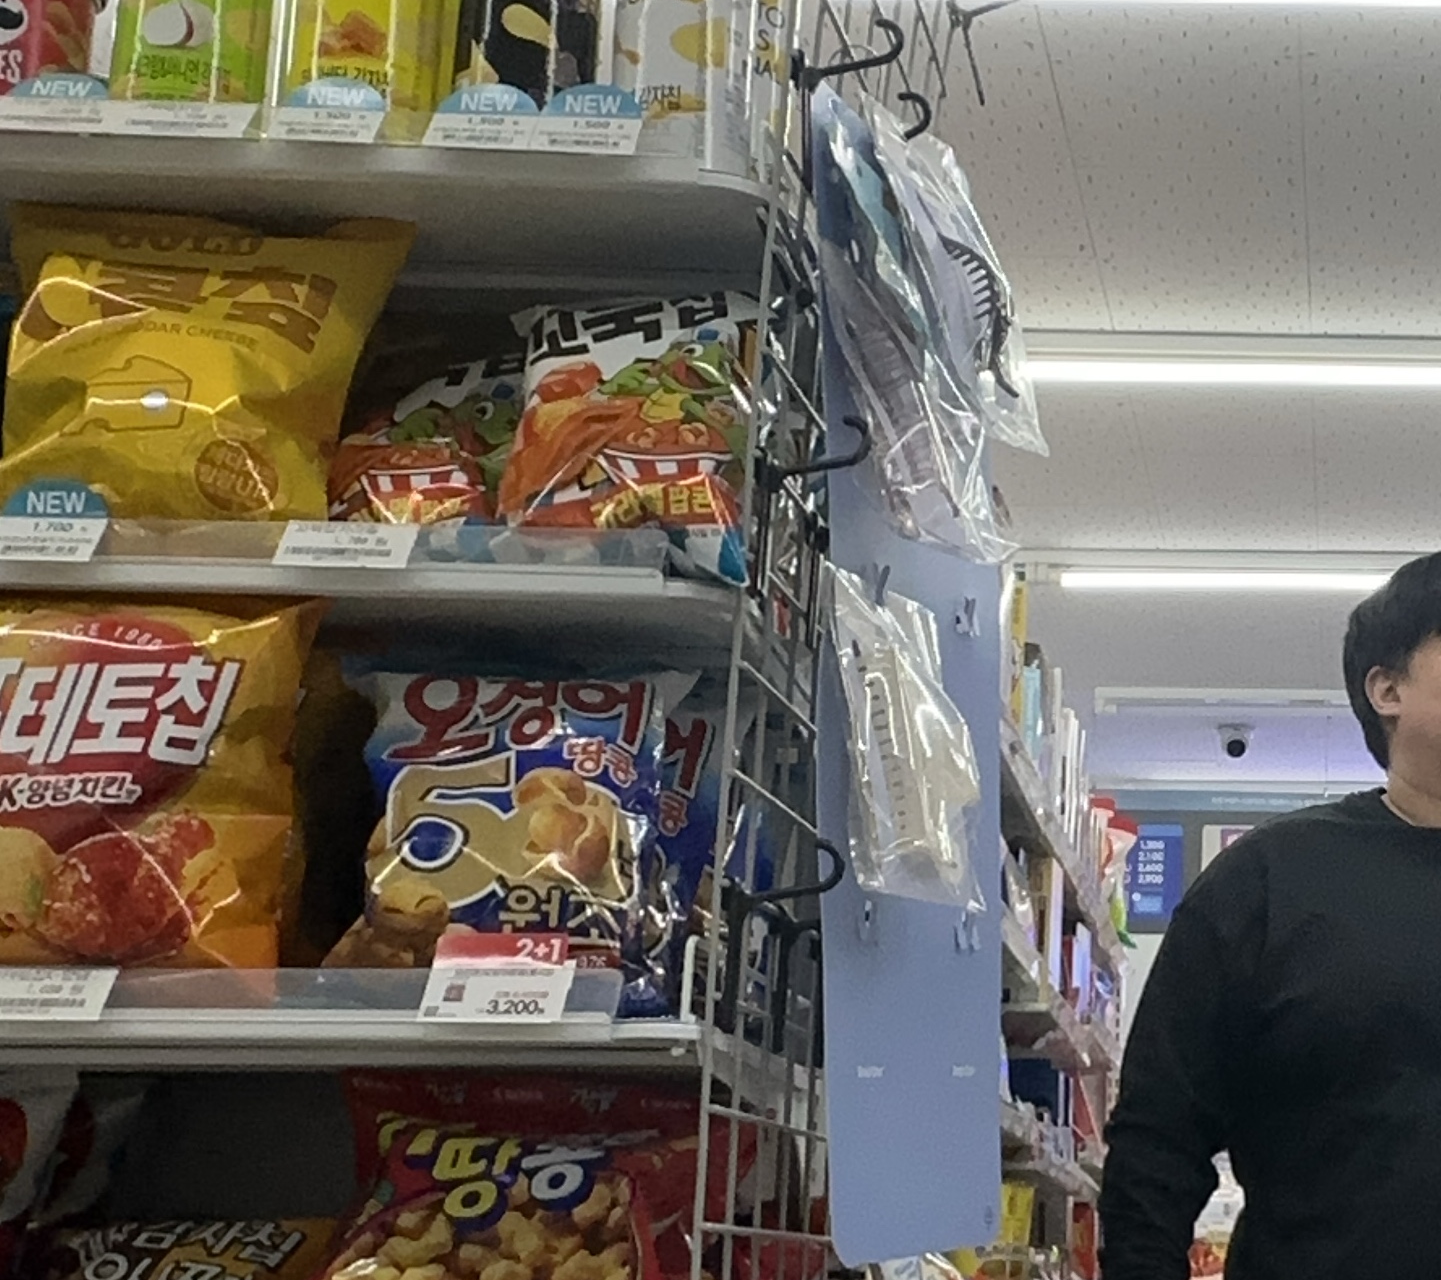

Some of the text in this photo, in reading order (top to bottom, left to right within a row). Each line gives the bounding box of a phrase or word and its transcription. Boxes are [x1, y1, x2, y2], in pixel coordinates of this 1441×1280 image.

[30, 79, 93, 97] NEW
[306, 87, 367, 108] NEW
[459, 91, 519, 112] NEW
[564, 95, 622, 114] NEW
[26, 490, 87, 514] NEW
[515, 937, 564, 963] 2+1
